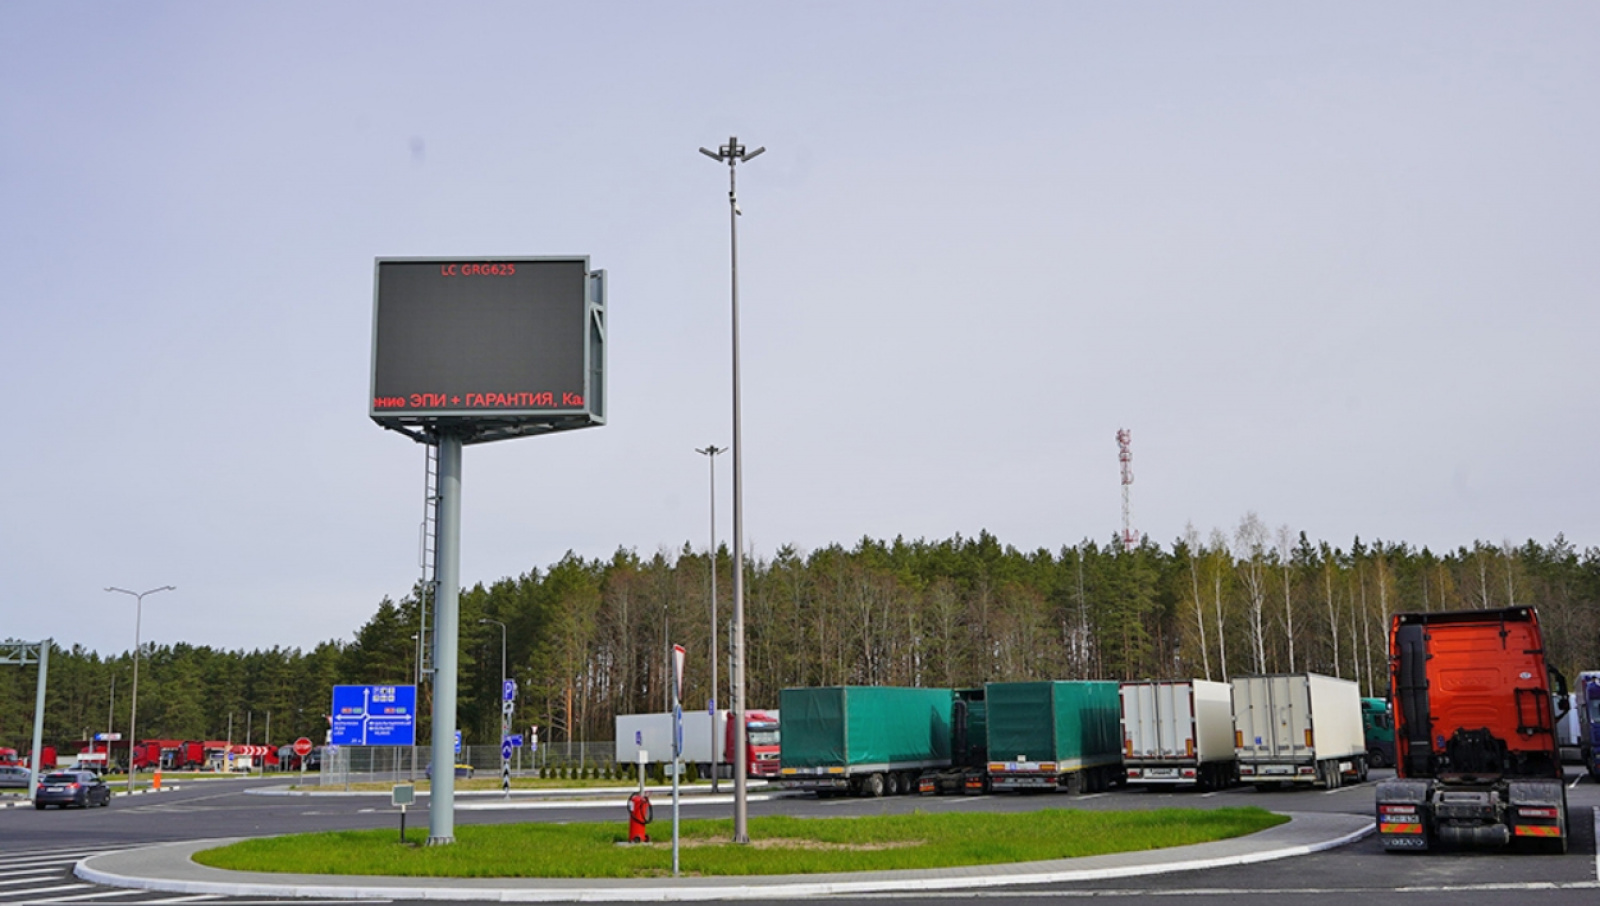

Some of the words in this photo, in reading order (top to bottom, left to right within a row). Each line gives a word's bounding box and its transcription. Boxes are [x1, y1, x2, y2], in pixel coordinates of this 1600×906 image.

[441, 264, 457, 277] LC
[461, 264, 516, 277] GRG625
[410, 393, 447, 408] ЭПИ
[451, 396, 460, 406] +
[465, 392, 559, 408] ГАРАНТИЯ,
[1382, 838, 1424, 847] VOLVO
